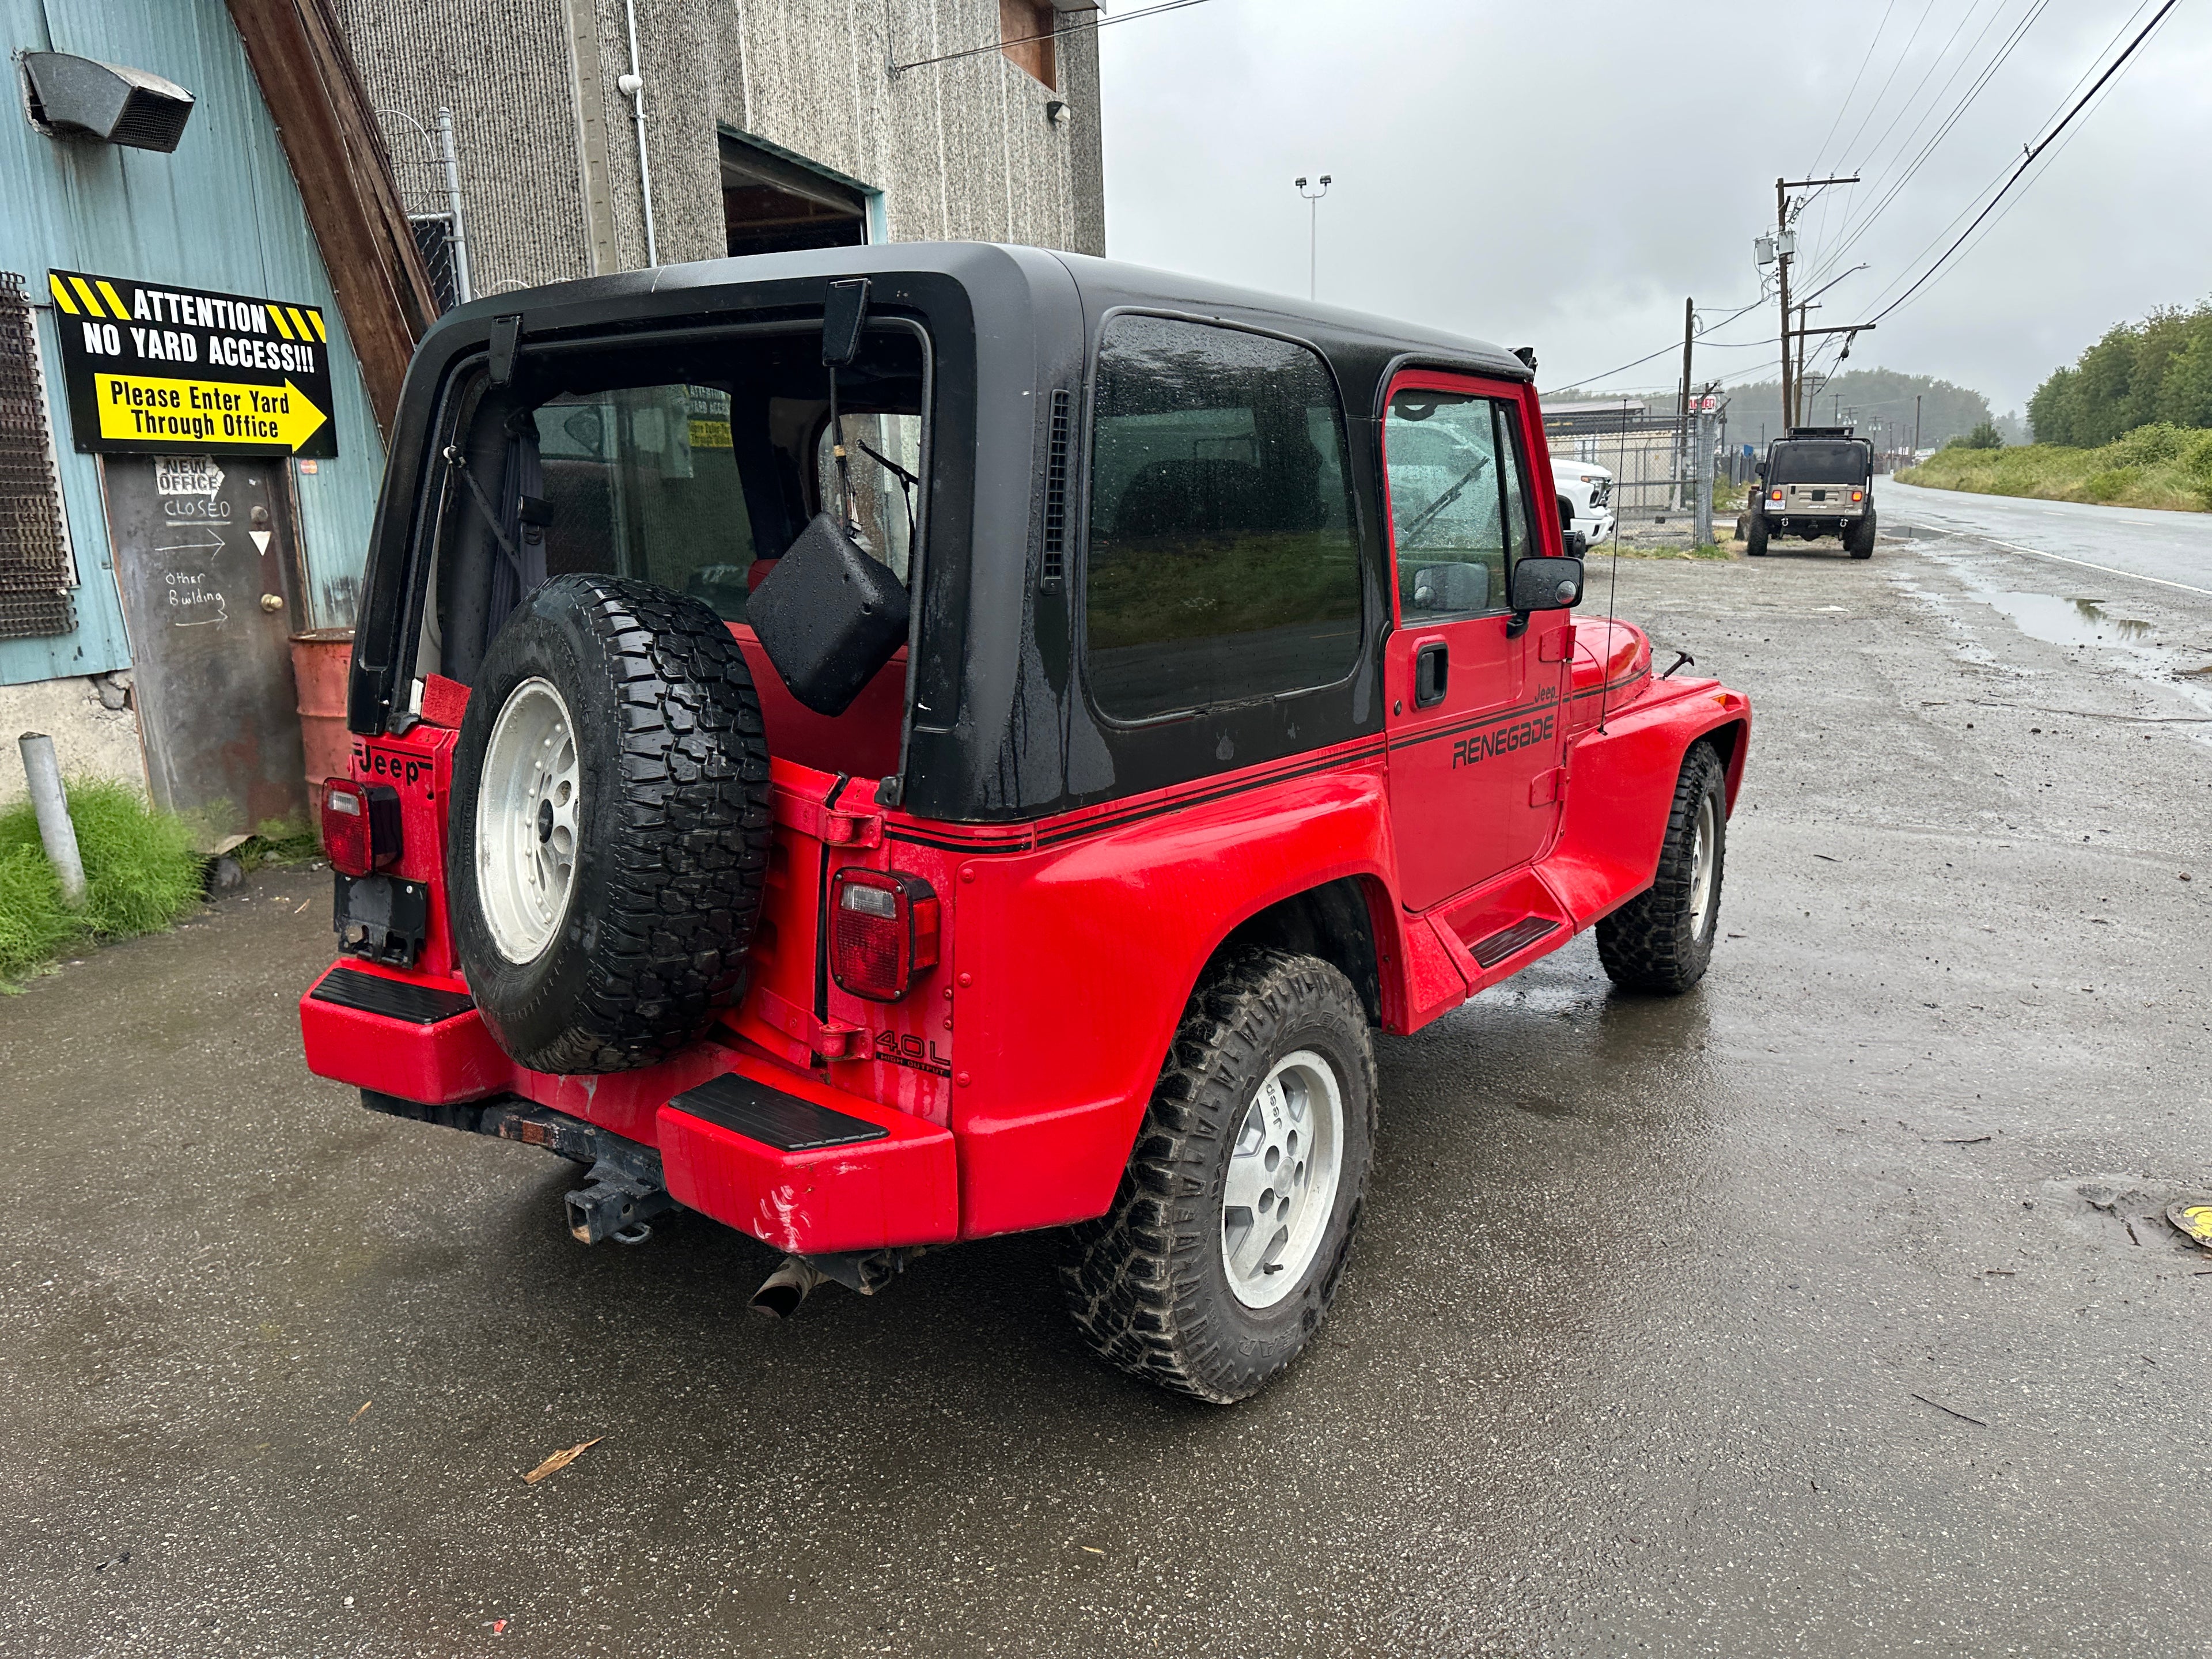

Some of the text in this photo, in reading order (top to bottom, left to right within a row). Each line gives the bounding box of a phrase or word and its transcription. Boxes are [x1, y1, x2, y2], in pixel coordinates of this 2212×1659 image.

[134, 289, 267, 334] ATTENTION
[82, 322, 315, 373] NO YARD ACCESS!!!
[111, 381, 290, 415] Please Enter Yard
[131, 409, 279, 440] Through Office
[164, 459, 206, 473] NEW
[159, 473, 217, 491] OFFICE
[164, 499, 230, 518] CLOSED
[169, 588, 225, 611] Building
[1534, 684, 1556, 703] Jeep
[1452, 715, 1554, 770] RENEGADE
[359, 745, 419, 786] Jeep
[881, 1054, 944, 1075] HIGH OUTPUT
[1266, 1084, 1282, 1130] Jeep
